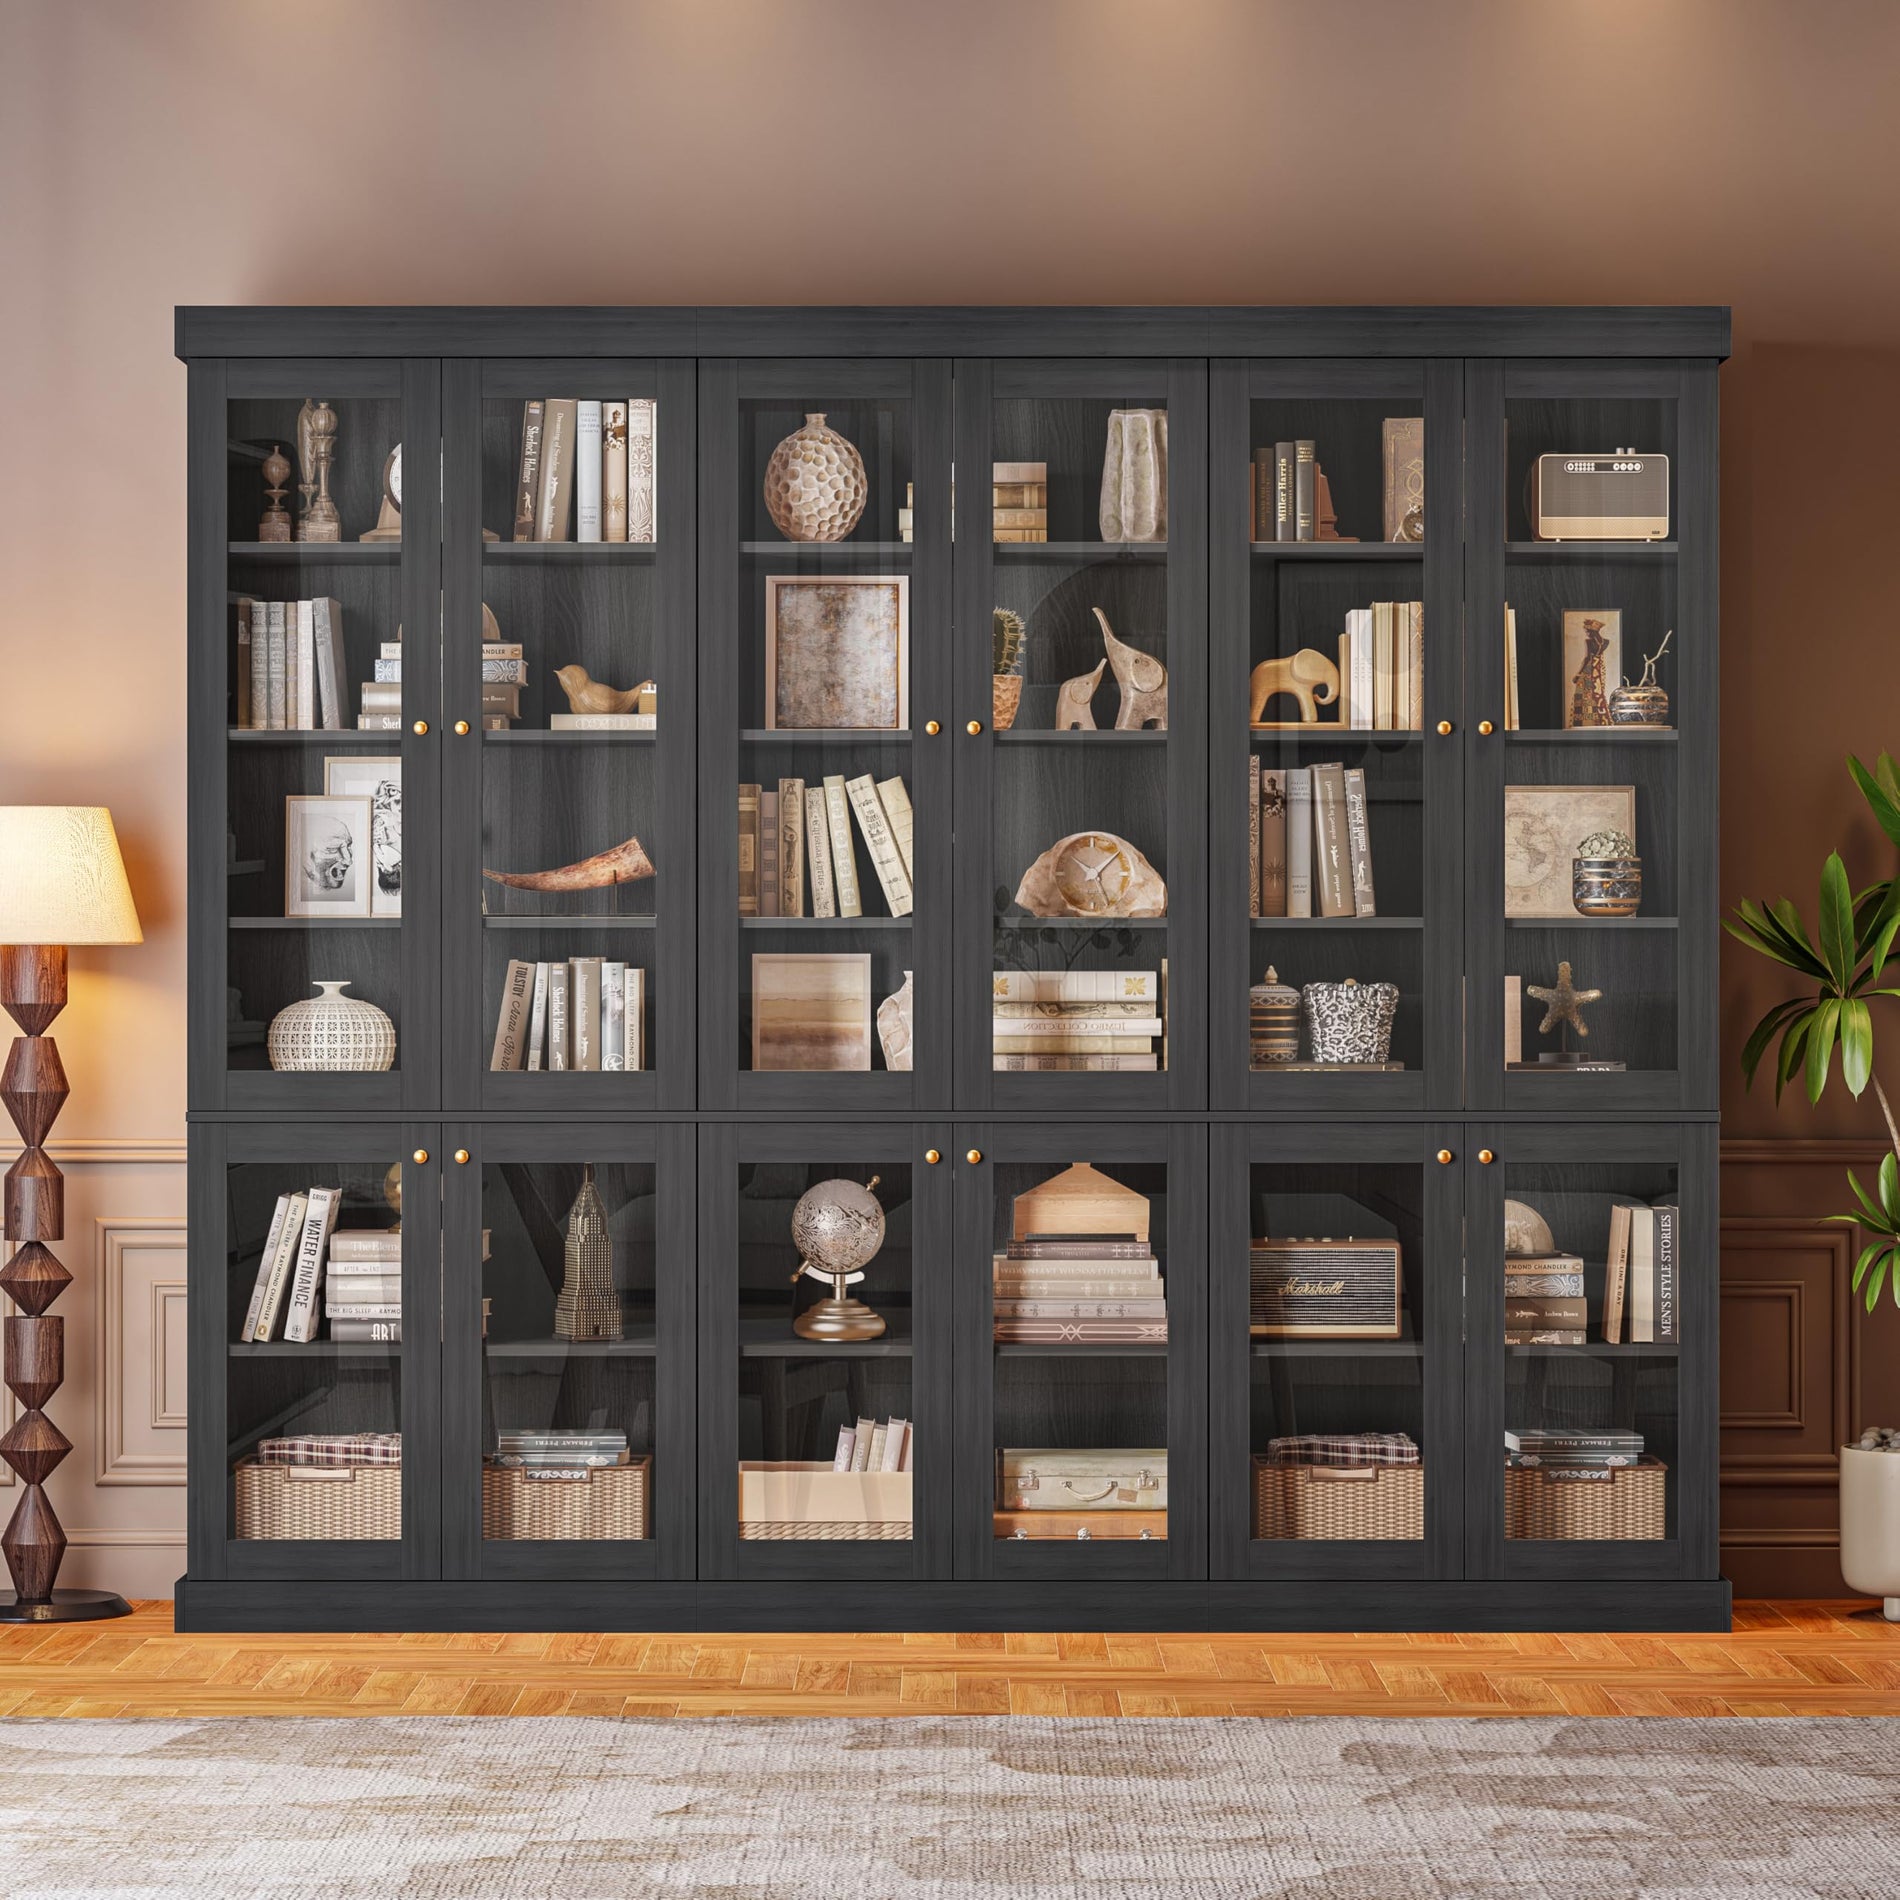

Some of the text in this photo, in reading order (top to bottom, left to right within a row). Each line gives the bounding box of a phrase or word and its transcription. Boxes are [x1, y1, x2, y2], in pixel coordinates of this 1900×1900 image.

[522, 425, 539, 483] Sherlock Holmes
[1278, 458, 1287, 522] Miller Harris
[512, 966, 528, 998] TOLSTOY
[507, 1000, 521, 1032] Anna
[552, 986, 565, 1043] Sherlock Holmes
[291, 1204, 299, 1216] THE
[272, 1254, 286, 1287] RAYMOND
[294, 1219, 323, 1309] WATER FINANCE
[1661, 1214, 1672, 1336] MEN'S STYLE STORIES
[1278, 1276, 1345, 1295] Marshall
[263, 1287, 277, 1321] CHANDLER
[370, 1323, 397, 1341] ART
